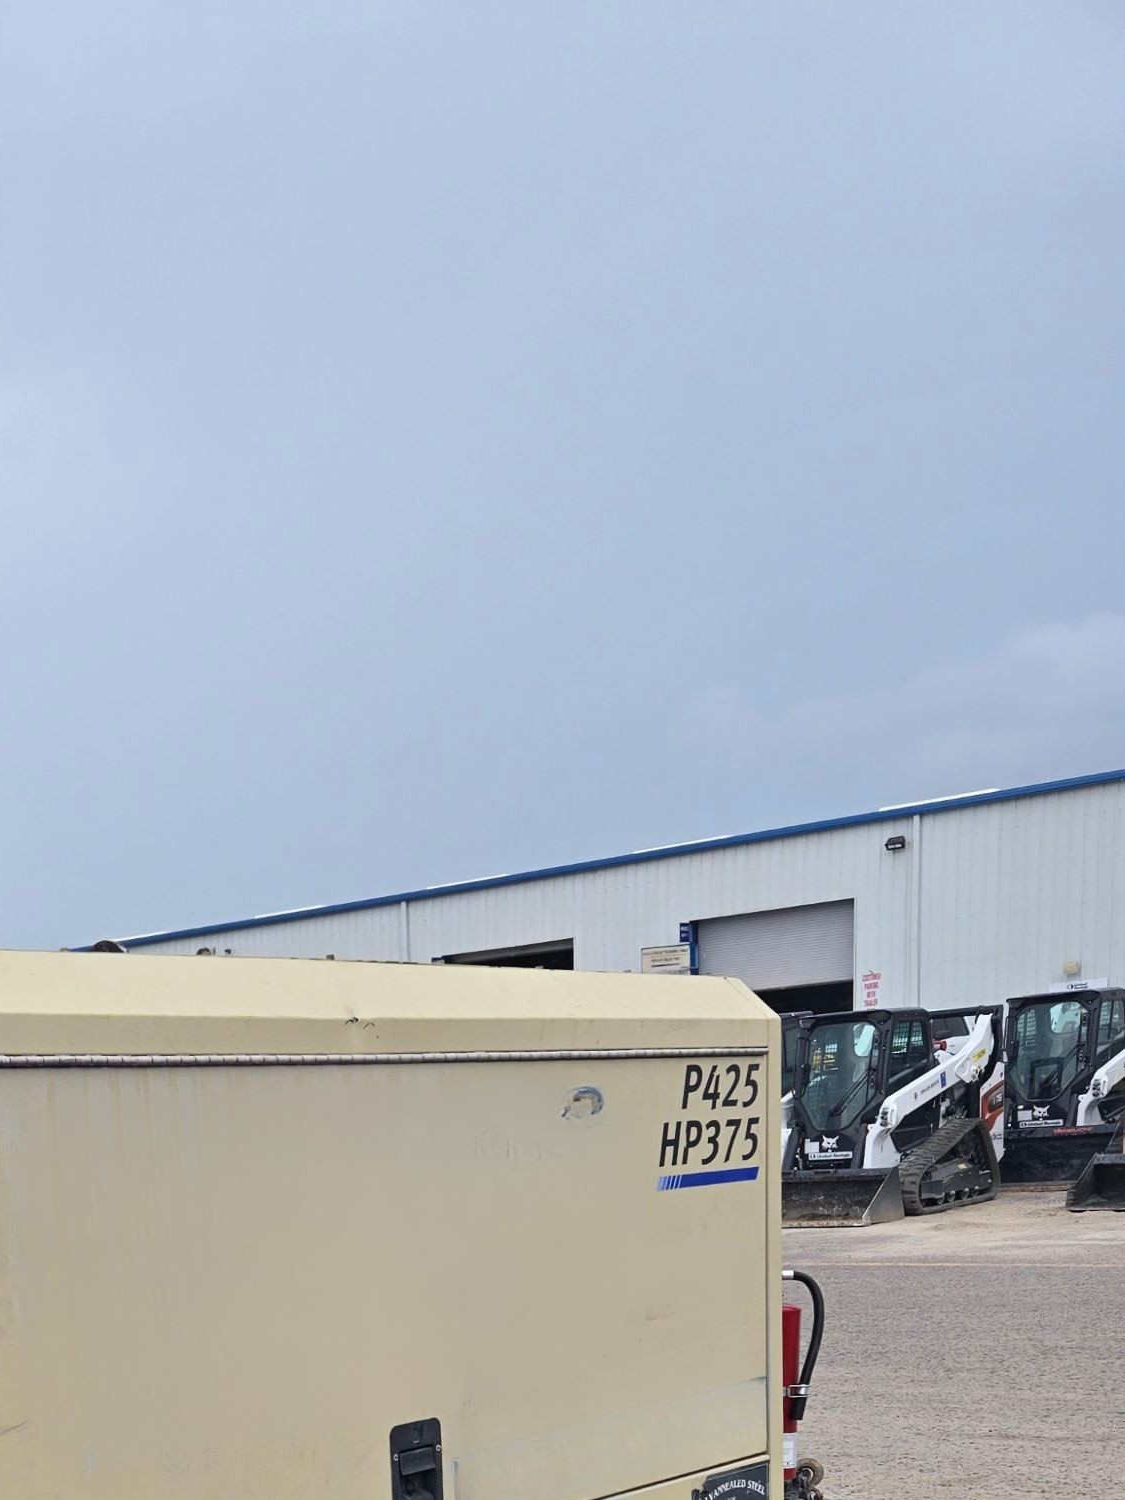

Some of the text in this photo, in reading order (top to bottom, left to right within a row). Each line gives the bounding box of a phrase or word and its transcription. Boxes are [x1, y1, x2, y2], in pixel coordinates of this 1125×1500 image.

[681, 1063, 761, 1110] P425
[658, 1117, 761, 1168] HP375
[747, 1480, 765, 1495] STEEL
